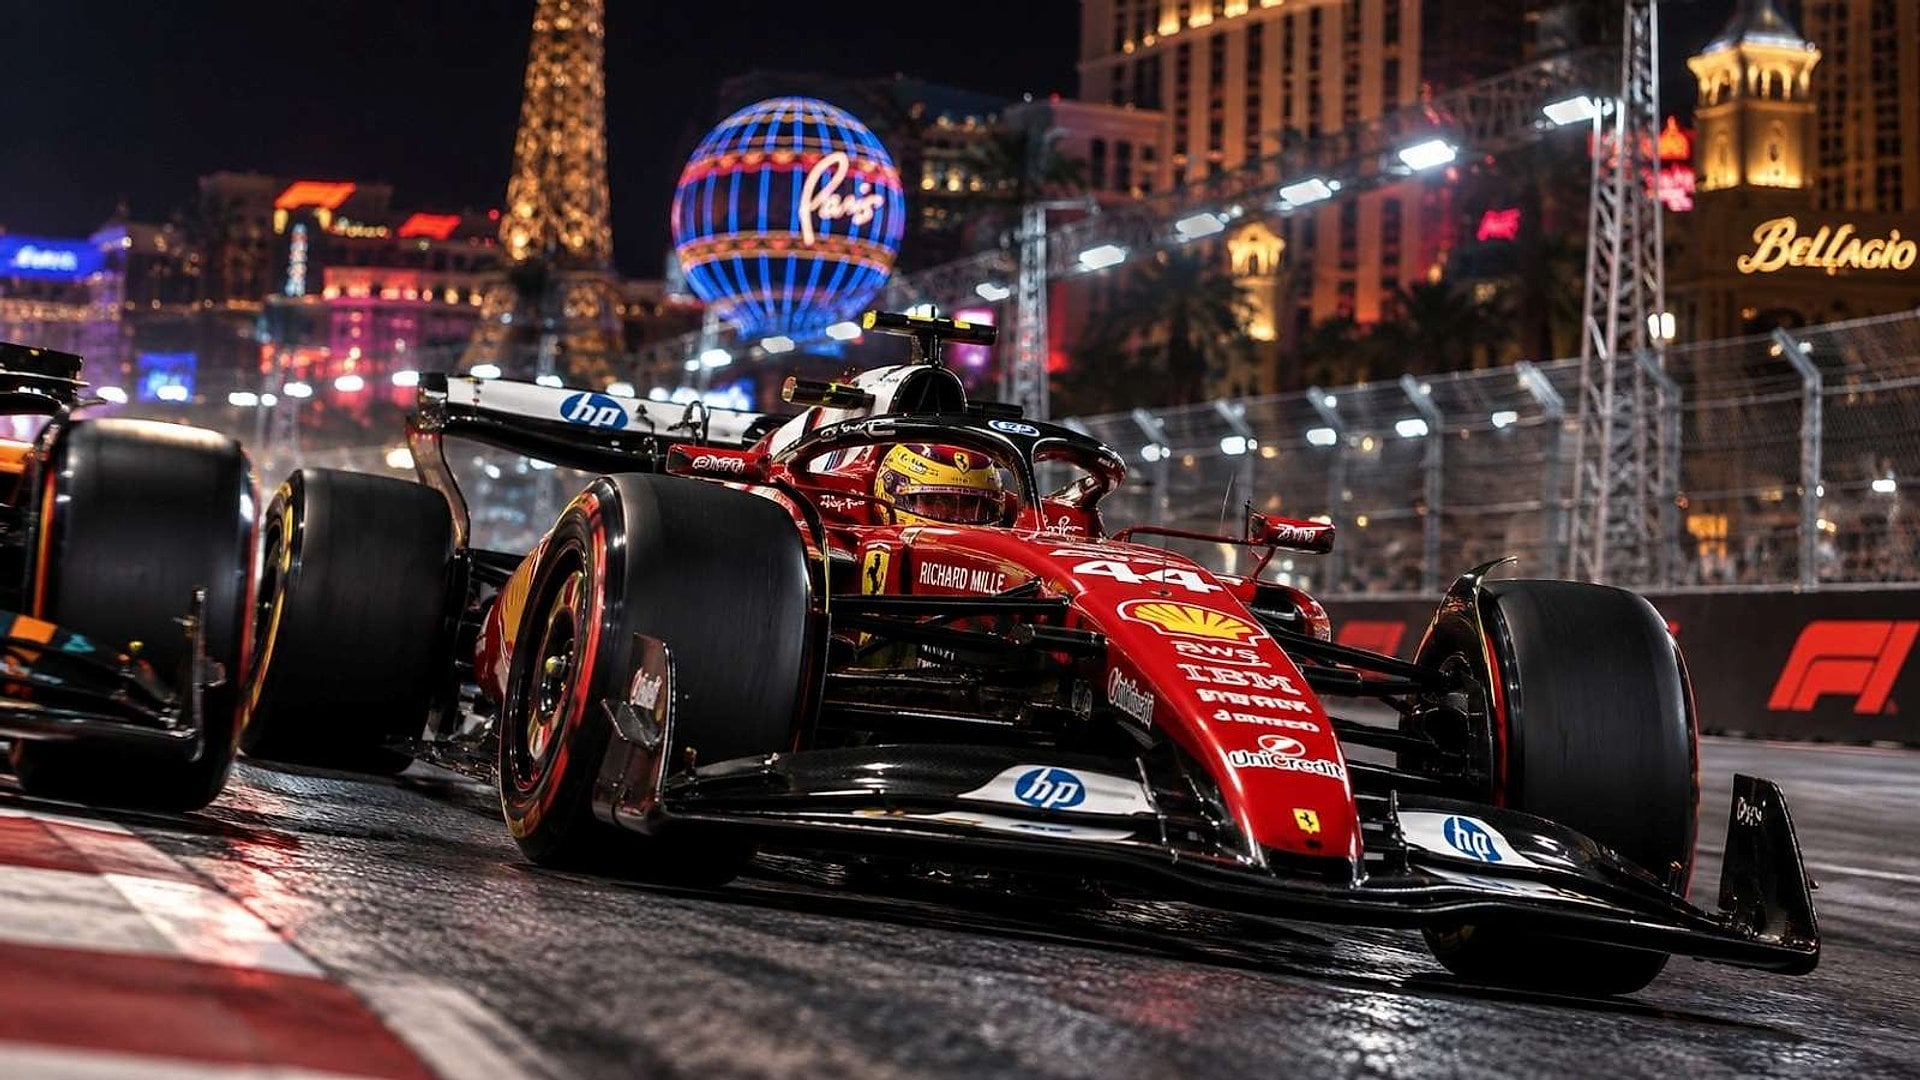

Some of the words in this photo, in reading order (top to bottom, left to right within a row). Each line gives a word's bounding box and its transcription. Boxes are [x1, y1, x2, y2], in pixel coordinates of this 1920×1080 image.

[798, 151, 885, 246] Paris
[568, 392, 622, 428] hp
[919, 561, 968, 590] RICHARD
[969, 569, 1005, 594] MILLE
[1073, 560, 1223, 593] 44
[1176, 663, 1301, 695] IBM
[1767, 620, 1919, 714] F1
[1021, 767, 1080, 809] hp
[1452, 816, 1491, 862] hp
